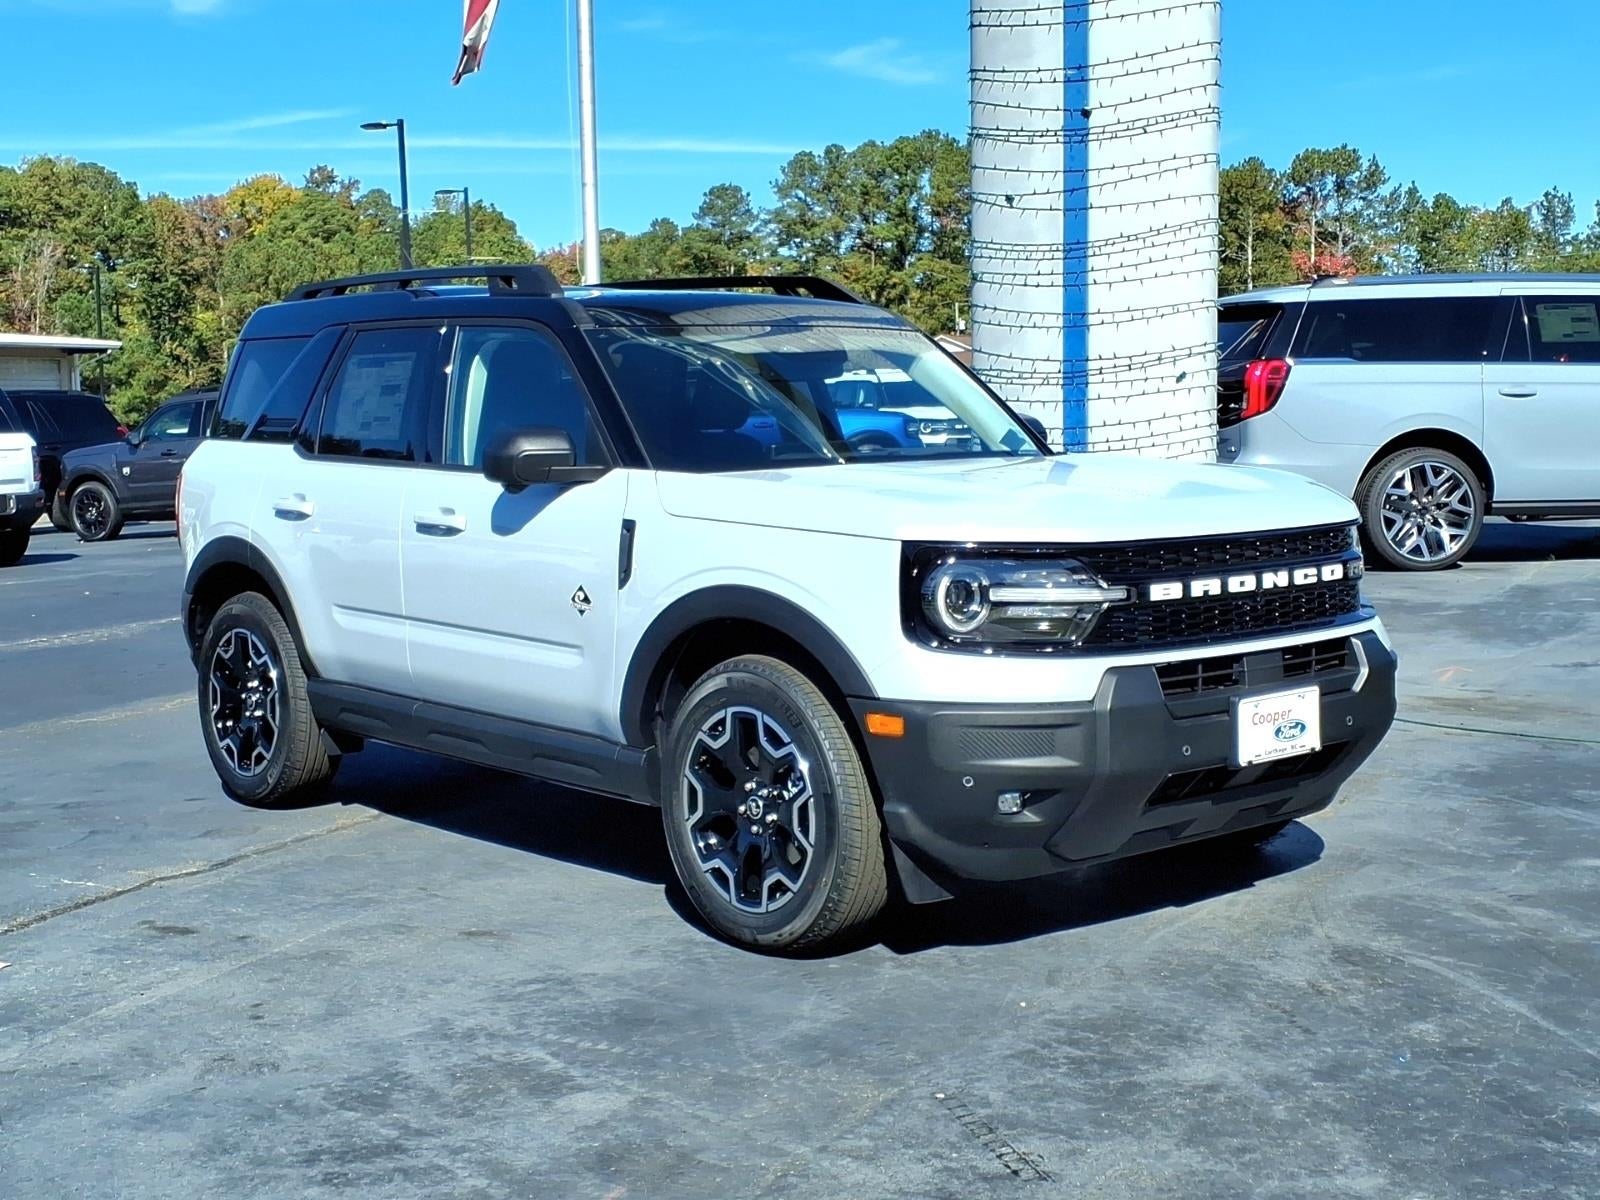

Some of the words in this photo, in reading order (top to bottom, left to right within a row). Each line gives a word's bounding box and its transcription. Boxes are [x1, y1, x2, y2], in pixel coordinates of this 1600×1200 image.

[1150, 564, 1343, 601] BRONCO
[1252, 709, 1292, 725] Cooper
[1277, 721, 1303, 739] Ford
